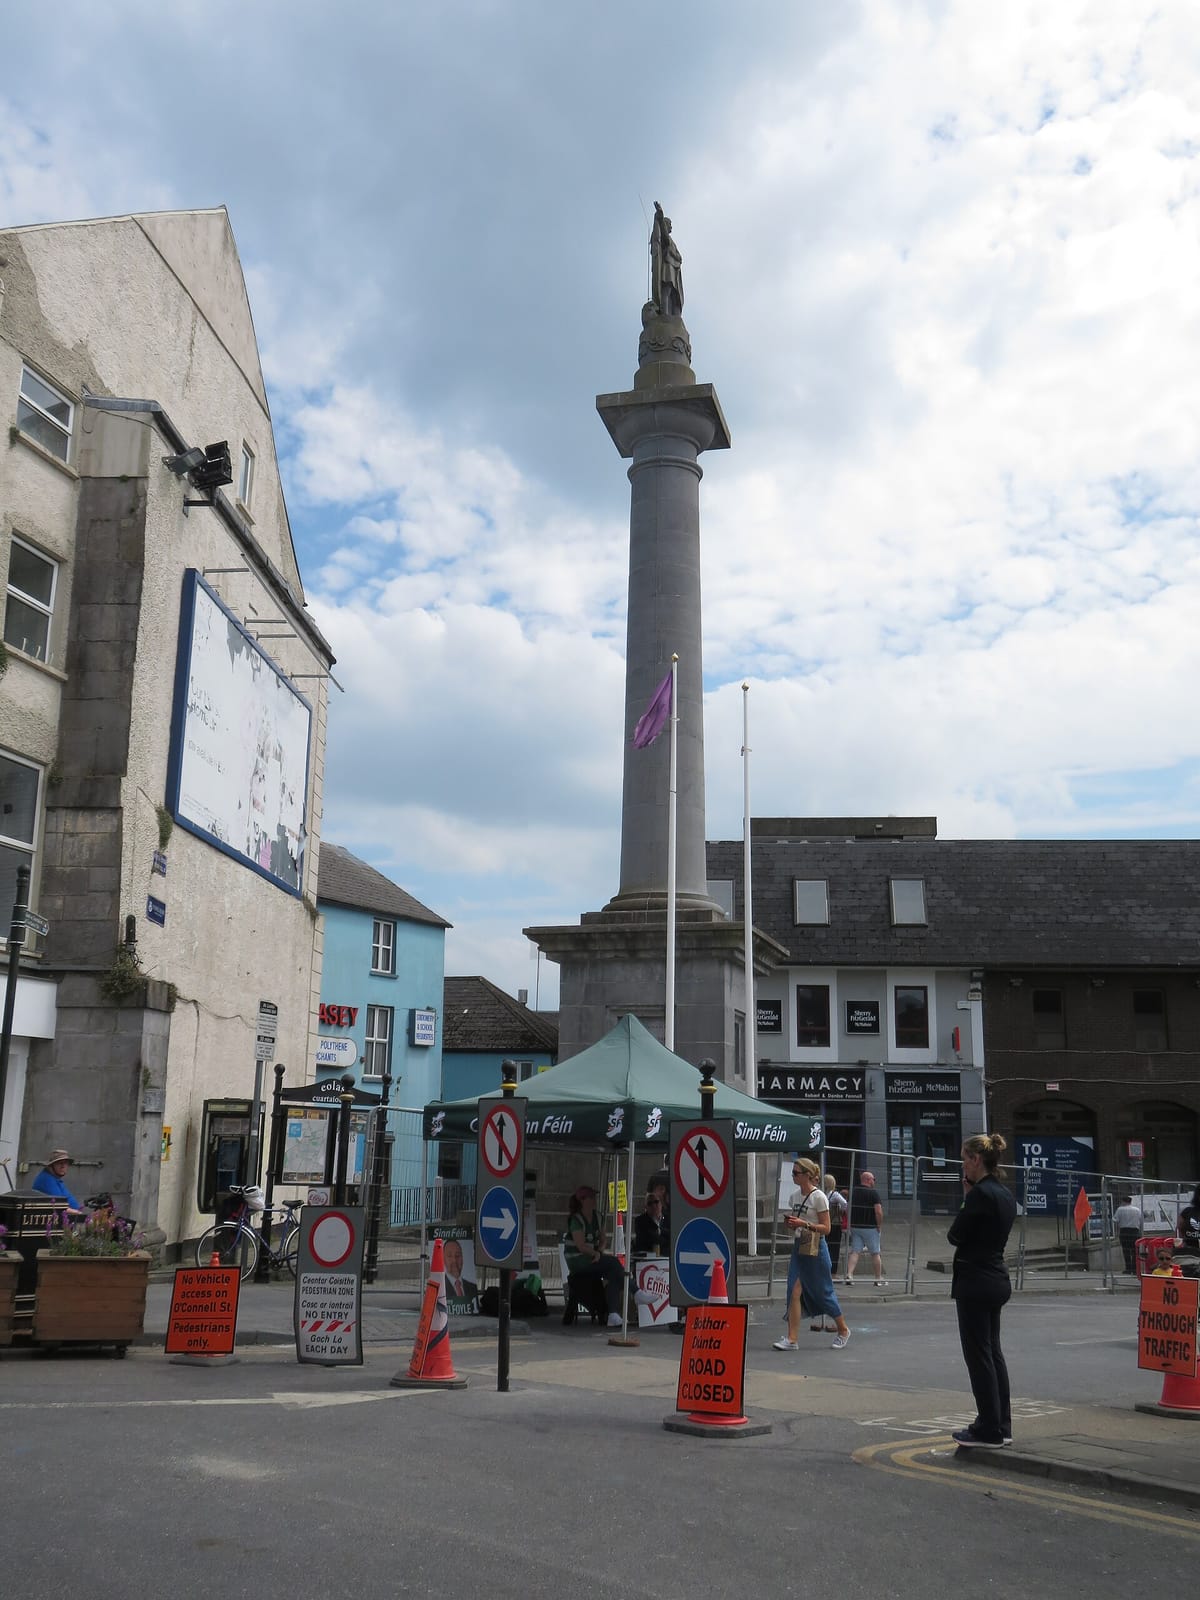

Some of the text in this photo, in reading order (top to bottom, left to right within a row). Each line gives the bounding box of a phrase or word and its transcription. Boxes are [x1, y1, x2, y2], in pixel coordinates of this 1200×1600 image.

[320, 1040, 348, 1051] POLYTHENE
[757, 1076, 862, 1091] HARMACY
[893, 1079, 915, 1088] Sherry
[926, 1083, 959, 1092] McMahon
[541, 1115, 573, 1134] Féin
[734, 1121, 787, 1142] Sinn Féin
[1022, 1143, 1042, 1156] TO
[1023, 1157, 1048, 1169] LET
[22, 1213, 60, 1226] LITTER
[433, 1227, 451, 1239] Sinn
[181, 1273, 231, 1285] No Vehicle
[180, 1289, 228, 1299] access on
[301, 1286, 354, 1296] PEDESTRIAN ZONE
[1162, 1287, 1180, 1306] NO
[173, 1302, 217, 1313] O'Connell
[305, 1310, 349, 1320] NO ENTRY
[173, 1322, 231, 1334] Pedestrians
[1141, 1310, 1195, 1335] THROUGH
[305, 1344, 349, 1355] EACH DAY
[1144, 1337, 1191, 1362] TRAFFIC
[688, 1357, 726, 1377] ROAD
[681, 1382, 735, 1404] CLOSED
